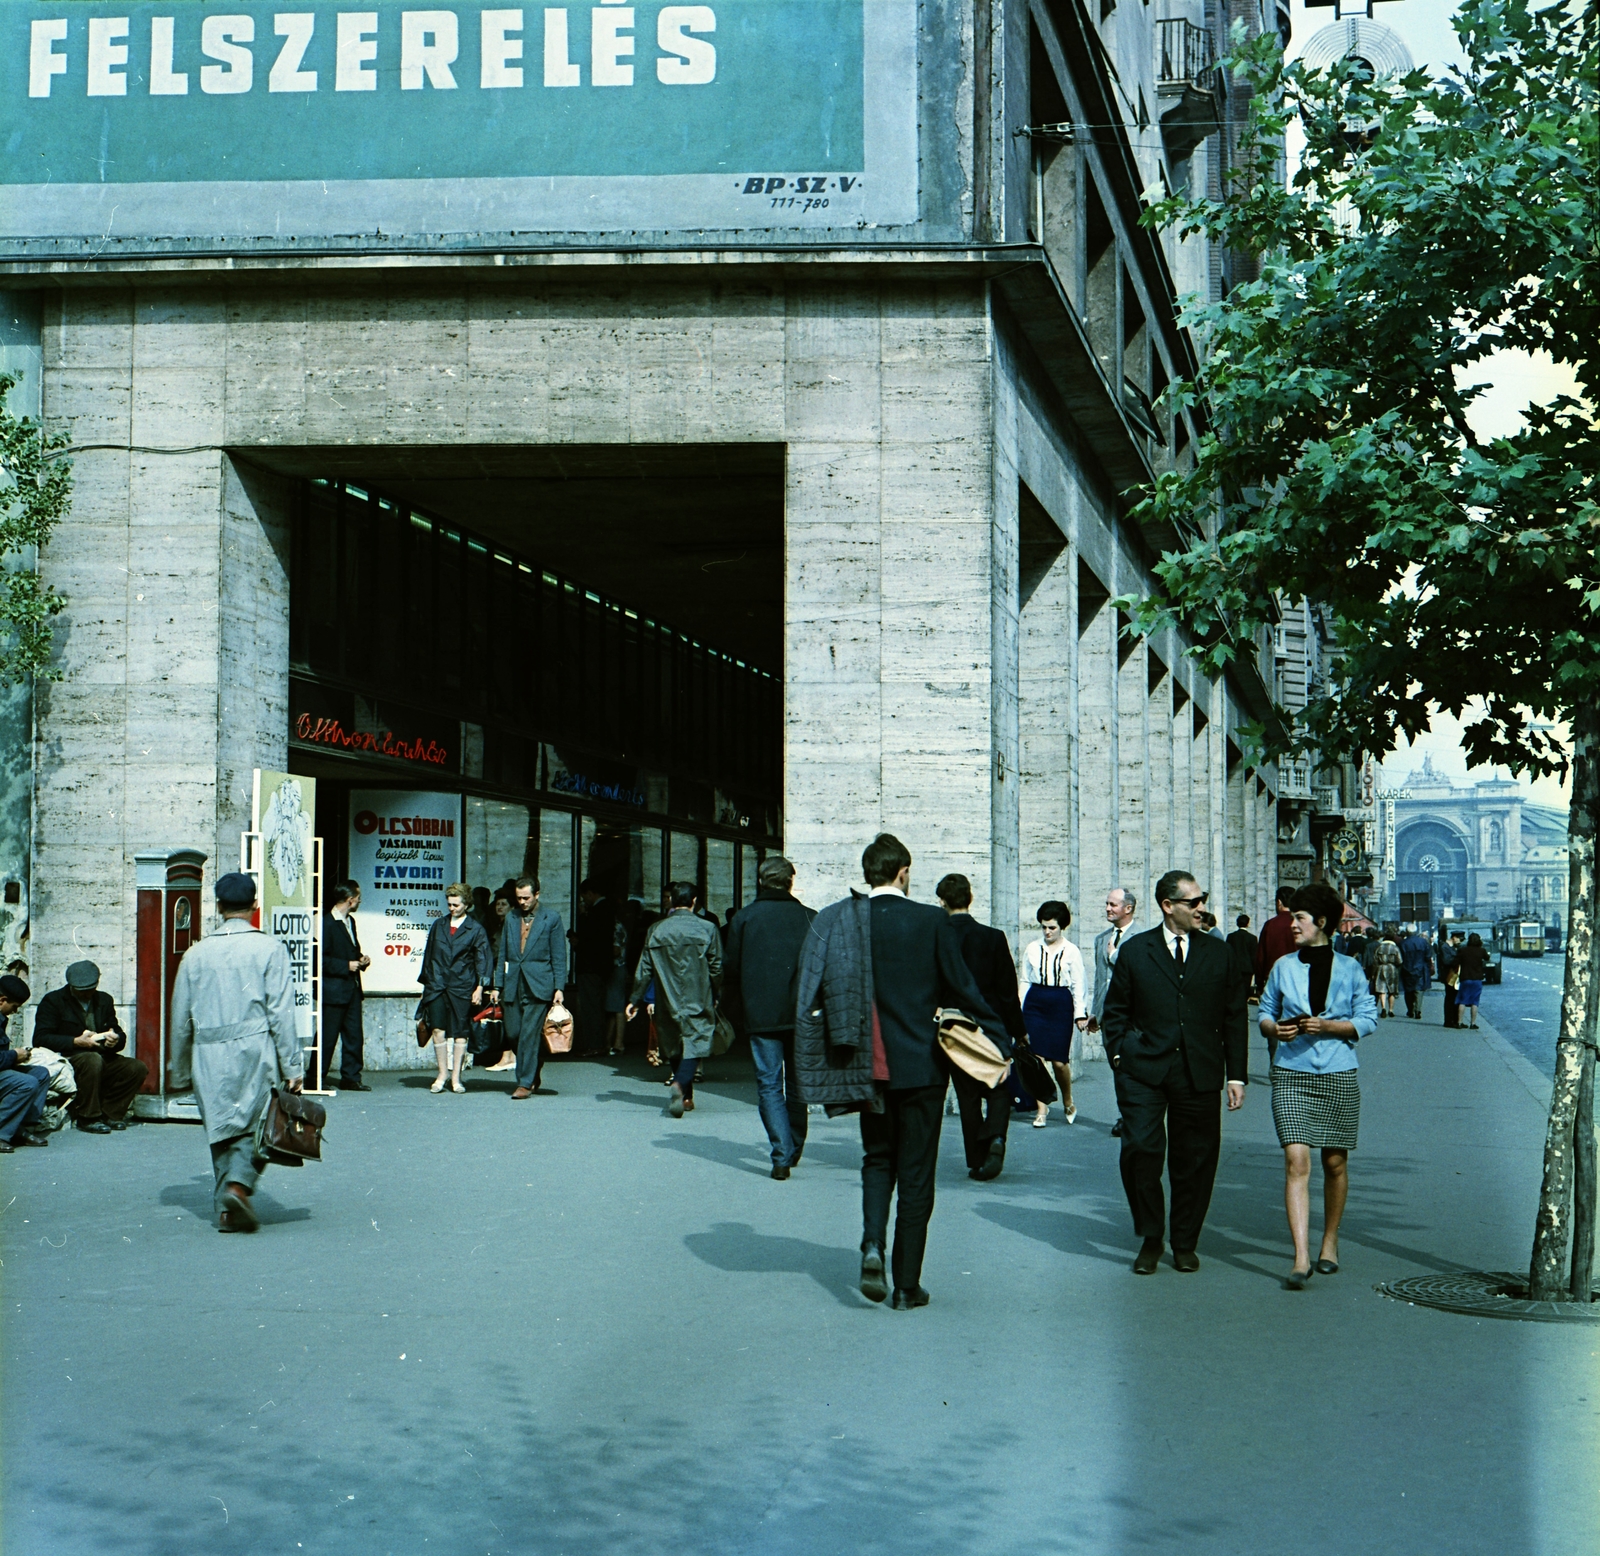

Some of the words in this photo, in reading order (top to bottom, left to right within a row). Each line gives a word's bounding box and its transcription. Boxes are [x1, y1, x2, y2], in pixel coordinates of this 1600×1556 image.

[29, 0, 717, 98] FELSZERELÉS
[771, 197, 830, 213] 111-780
[353, 810, 454, 837] OLCSÓBBAN
[375, 866, 444, 879] FAVORIT
[274, 914, 311, 935] LOTTO
[384, 944, 411, 956] OTP
